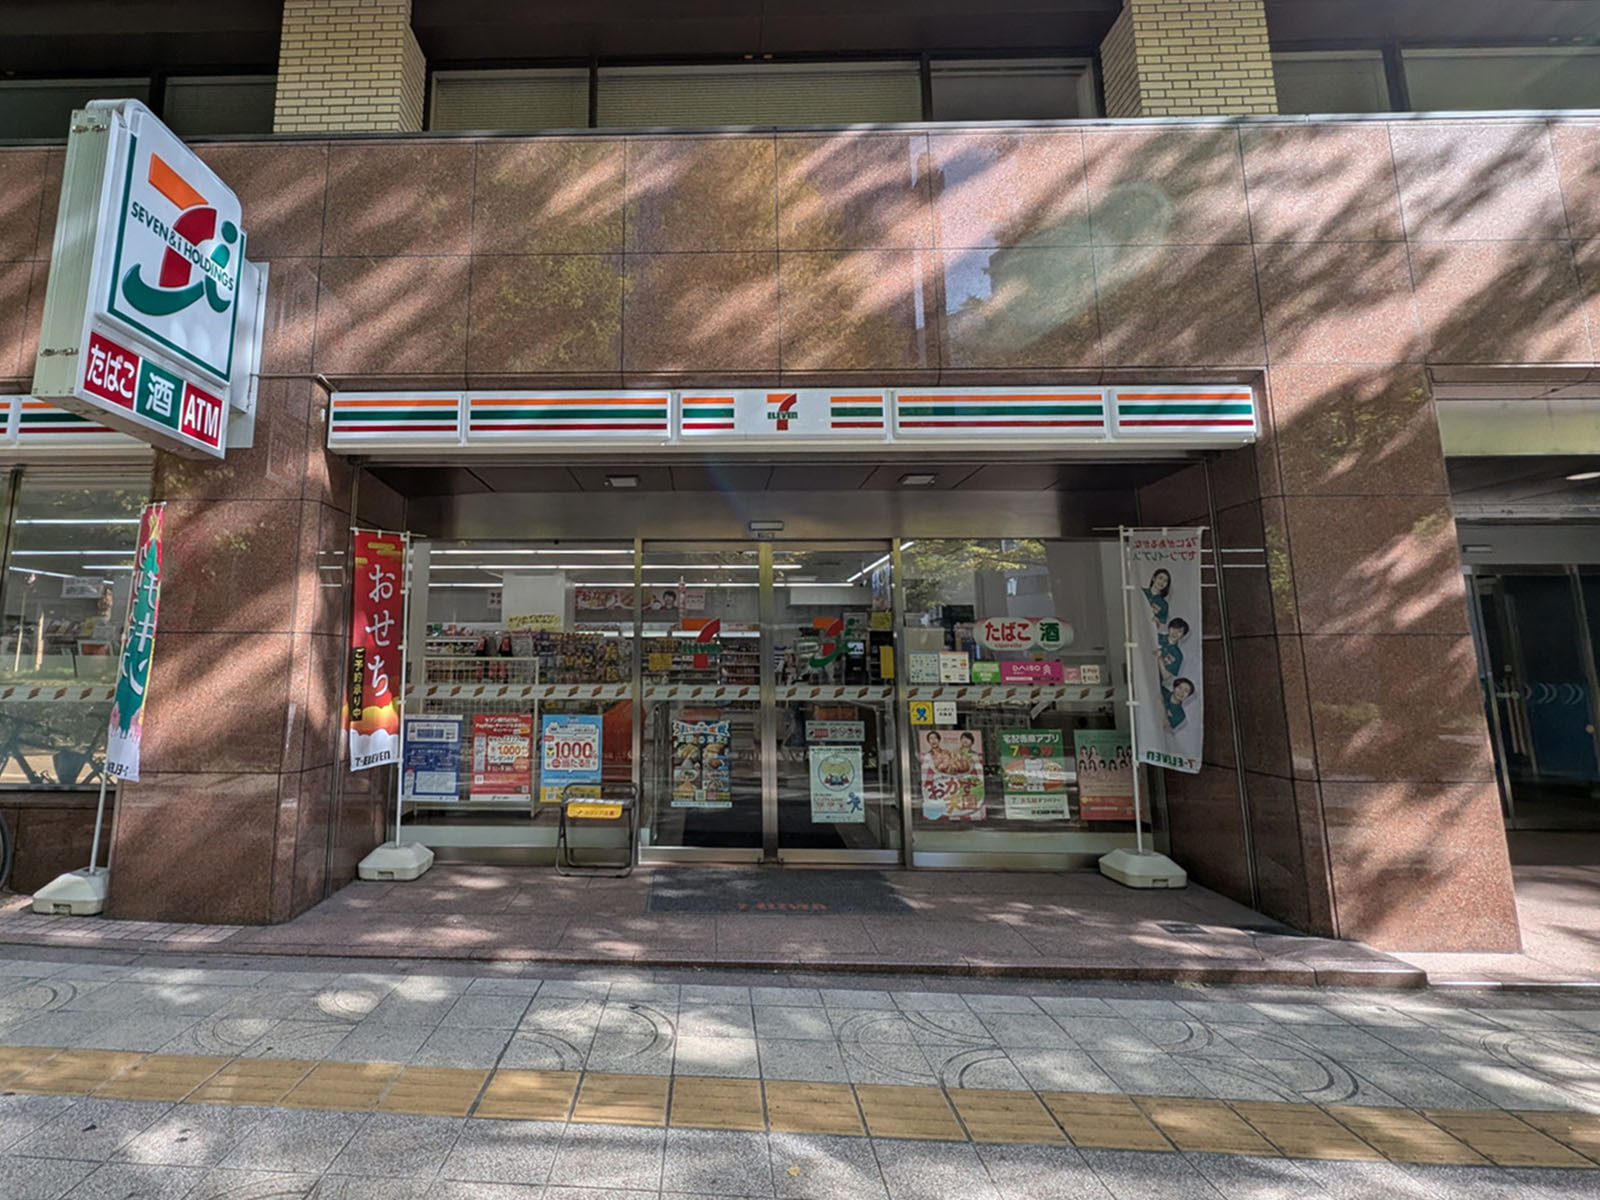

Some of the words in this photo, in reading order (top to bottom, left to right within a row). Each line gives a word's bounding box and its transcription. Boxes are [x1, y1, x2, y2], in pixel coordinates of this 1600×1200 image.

[183, 241, 234, 292] HOLDINGS
[87, 343, 135, 400] たばこ
[147, 372, 173, 418] 酒
[184, 394, 220, 440] ATM
[364, 563, 396, 697] おせち
[985, 622, 1031, 642] たばこ
[1039, 622, 1060, 642] 酒
[1012, 664, 1041, 673] DAISO
[923, 776, 977, 800] おかず
